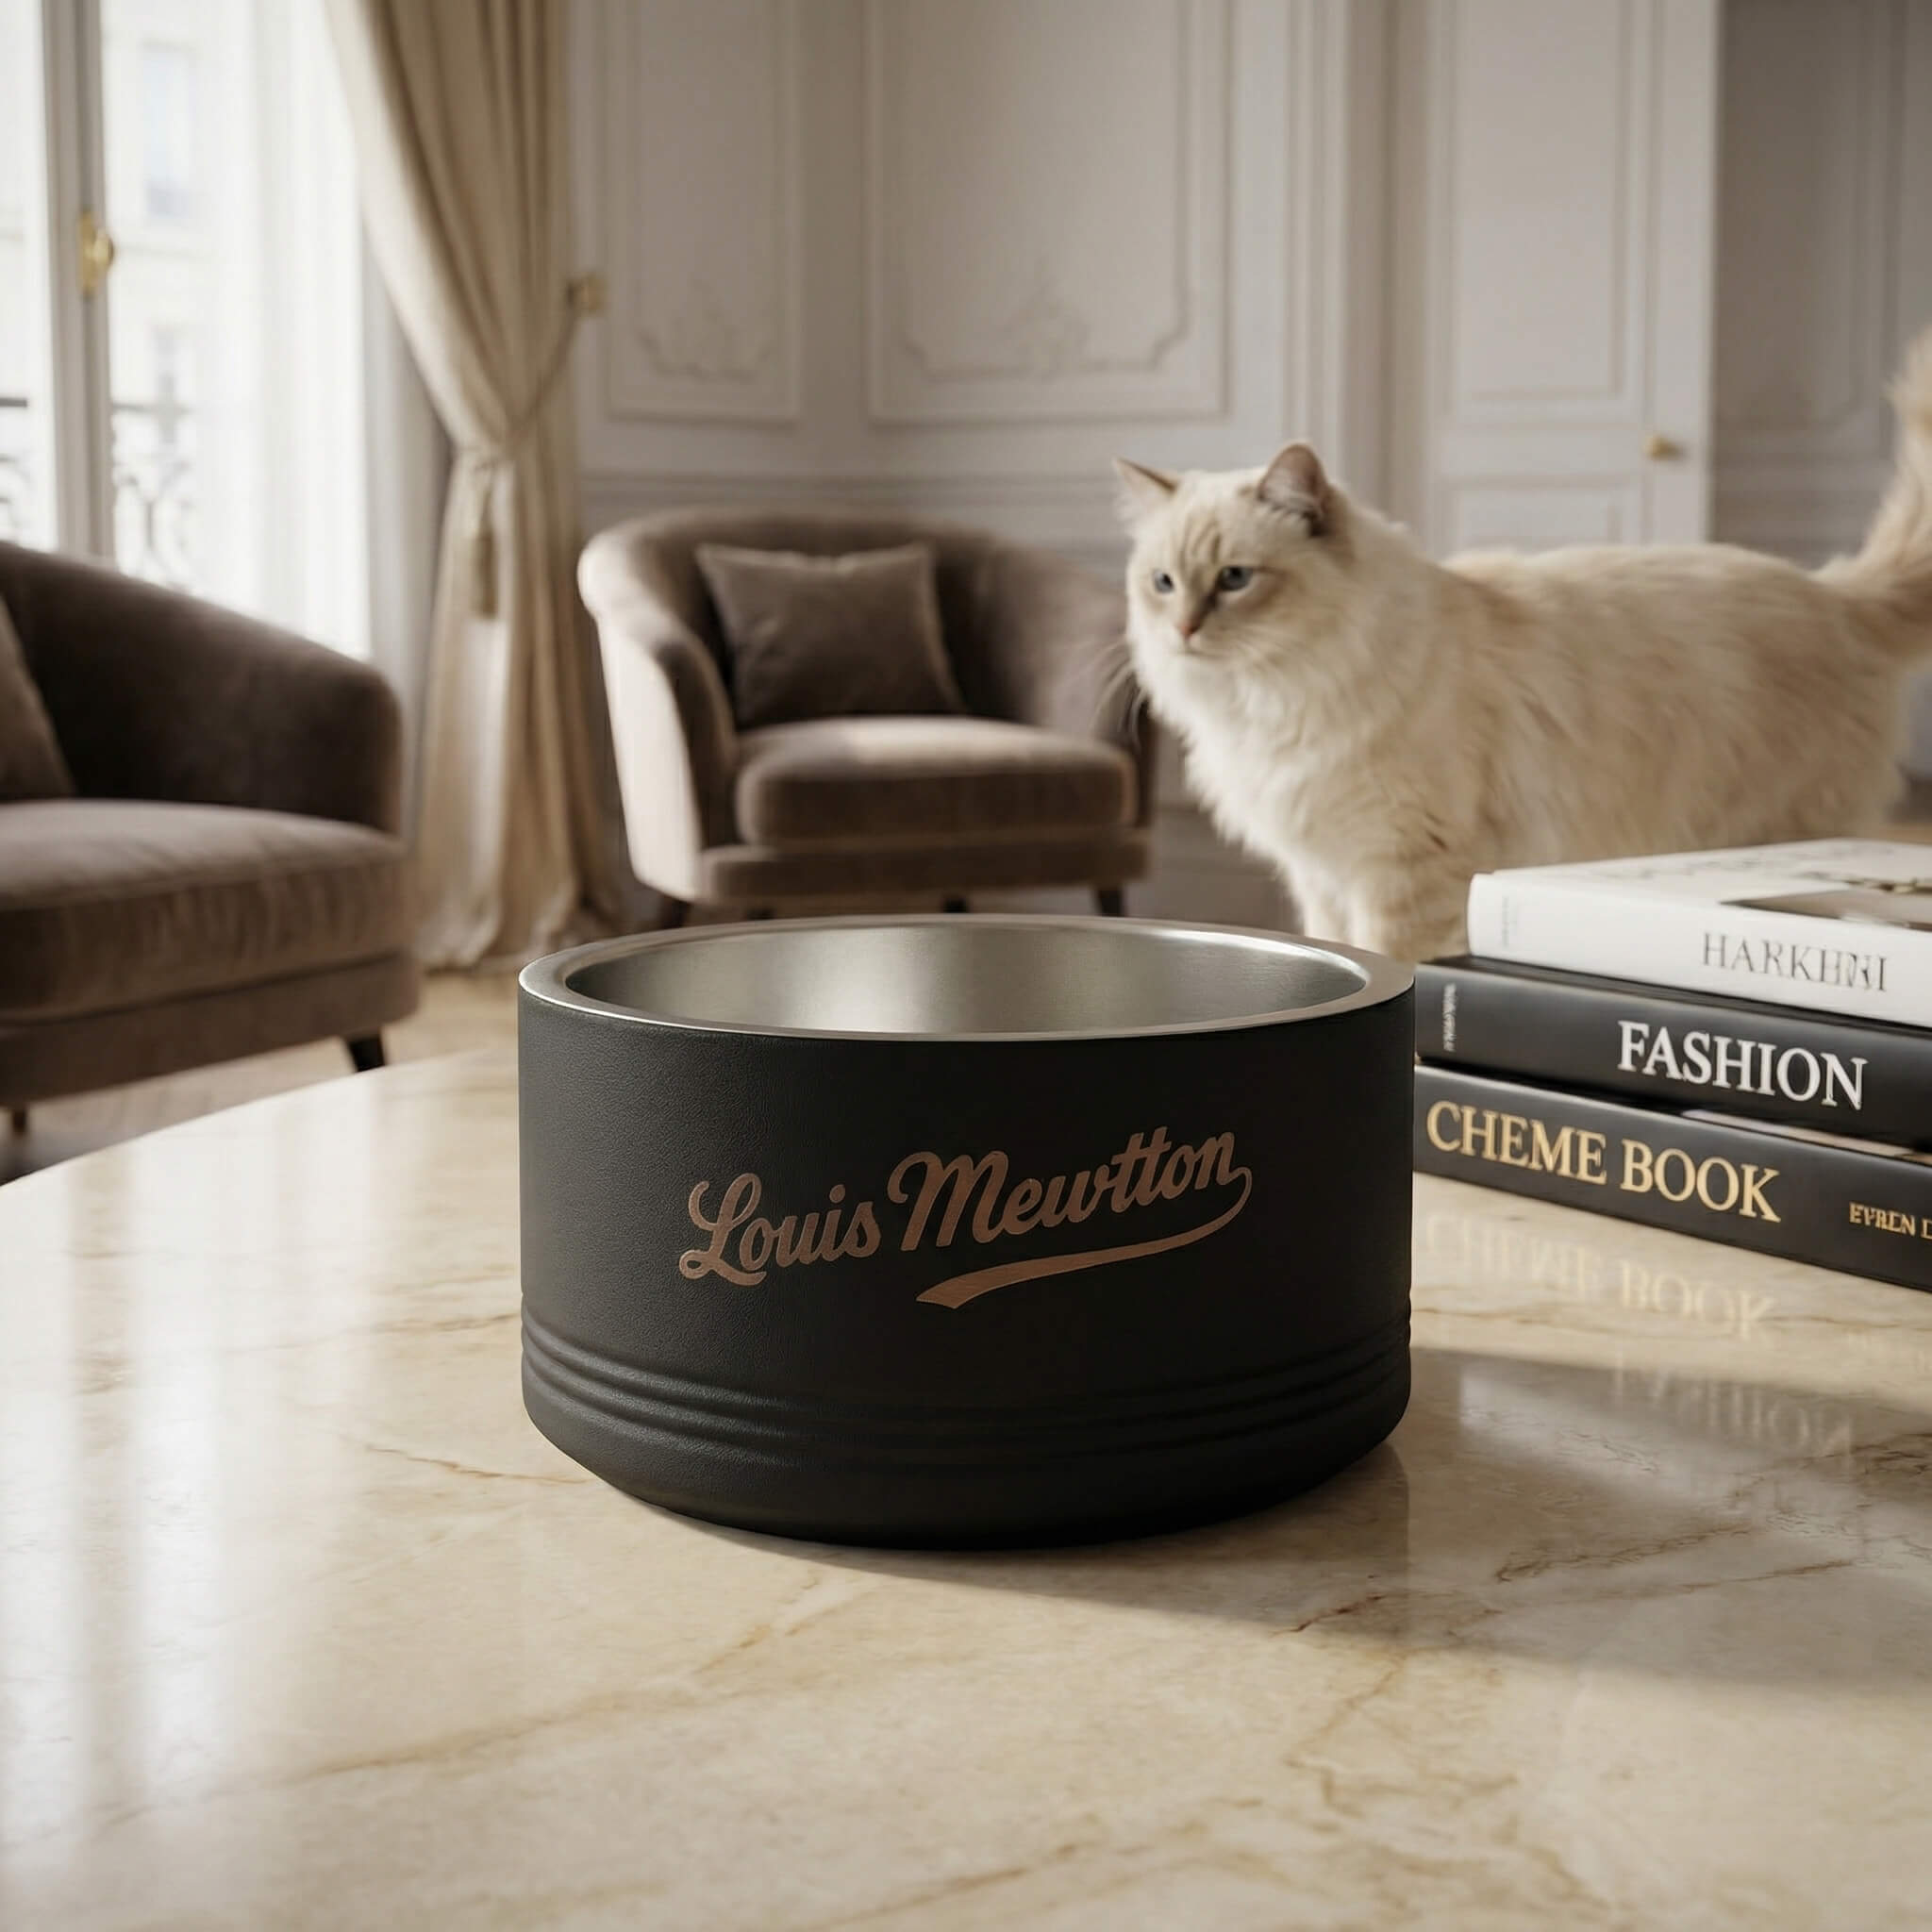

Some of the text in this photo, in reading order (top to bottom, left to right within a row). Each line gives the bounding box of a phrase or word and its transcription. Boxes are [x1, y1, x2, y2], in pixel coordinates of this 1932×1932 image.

[1616, 1020, 1868, 1109] FASHION
[679, 1126, 1252, 1286] Louis Mewtton
[1427, 1100, 1781, 1222] CHEME BOOK
